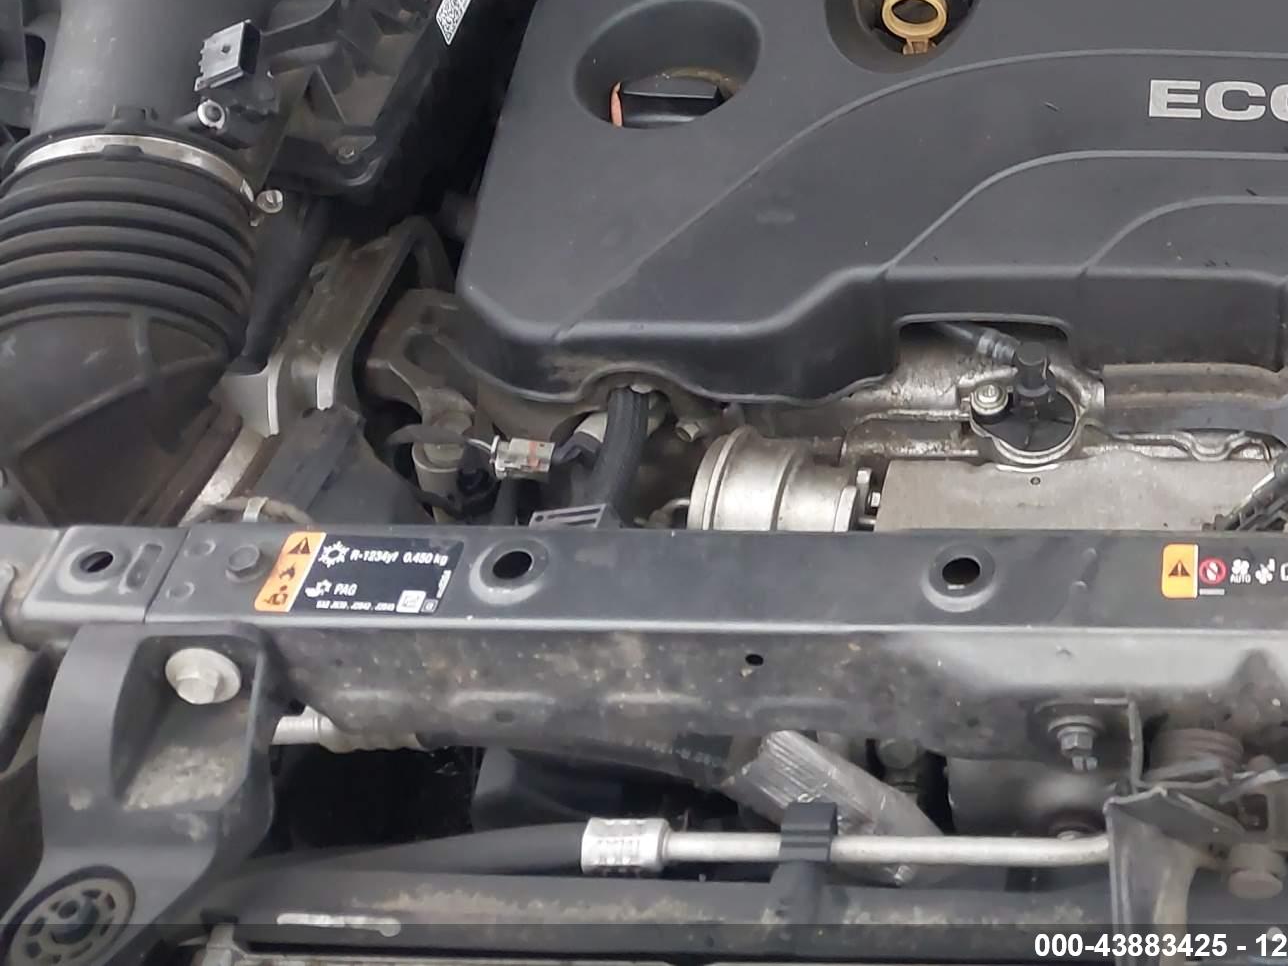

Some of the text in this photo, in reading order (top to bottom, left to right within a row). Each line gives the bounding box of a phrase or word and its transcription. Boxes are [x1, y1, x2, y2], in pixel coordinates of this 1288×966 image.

[433, 553, 448, 566] kg
[1230, 573, 1252, 584] AUTO
[333, 583, 358, 596] PAG
